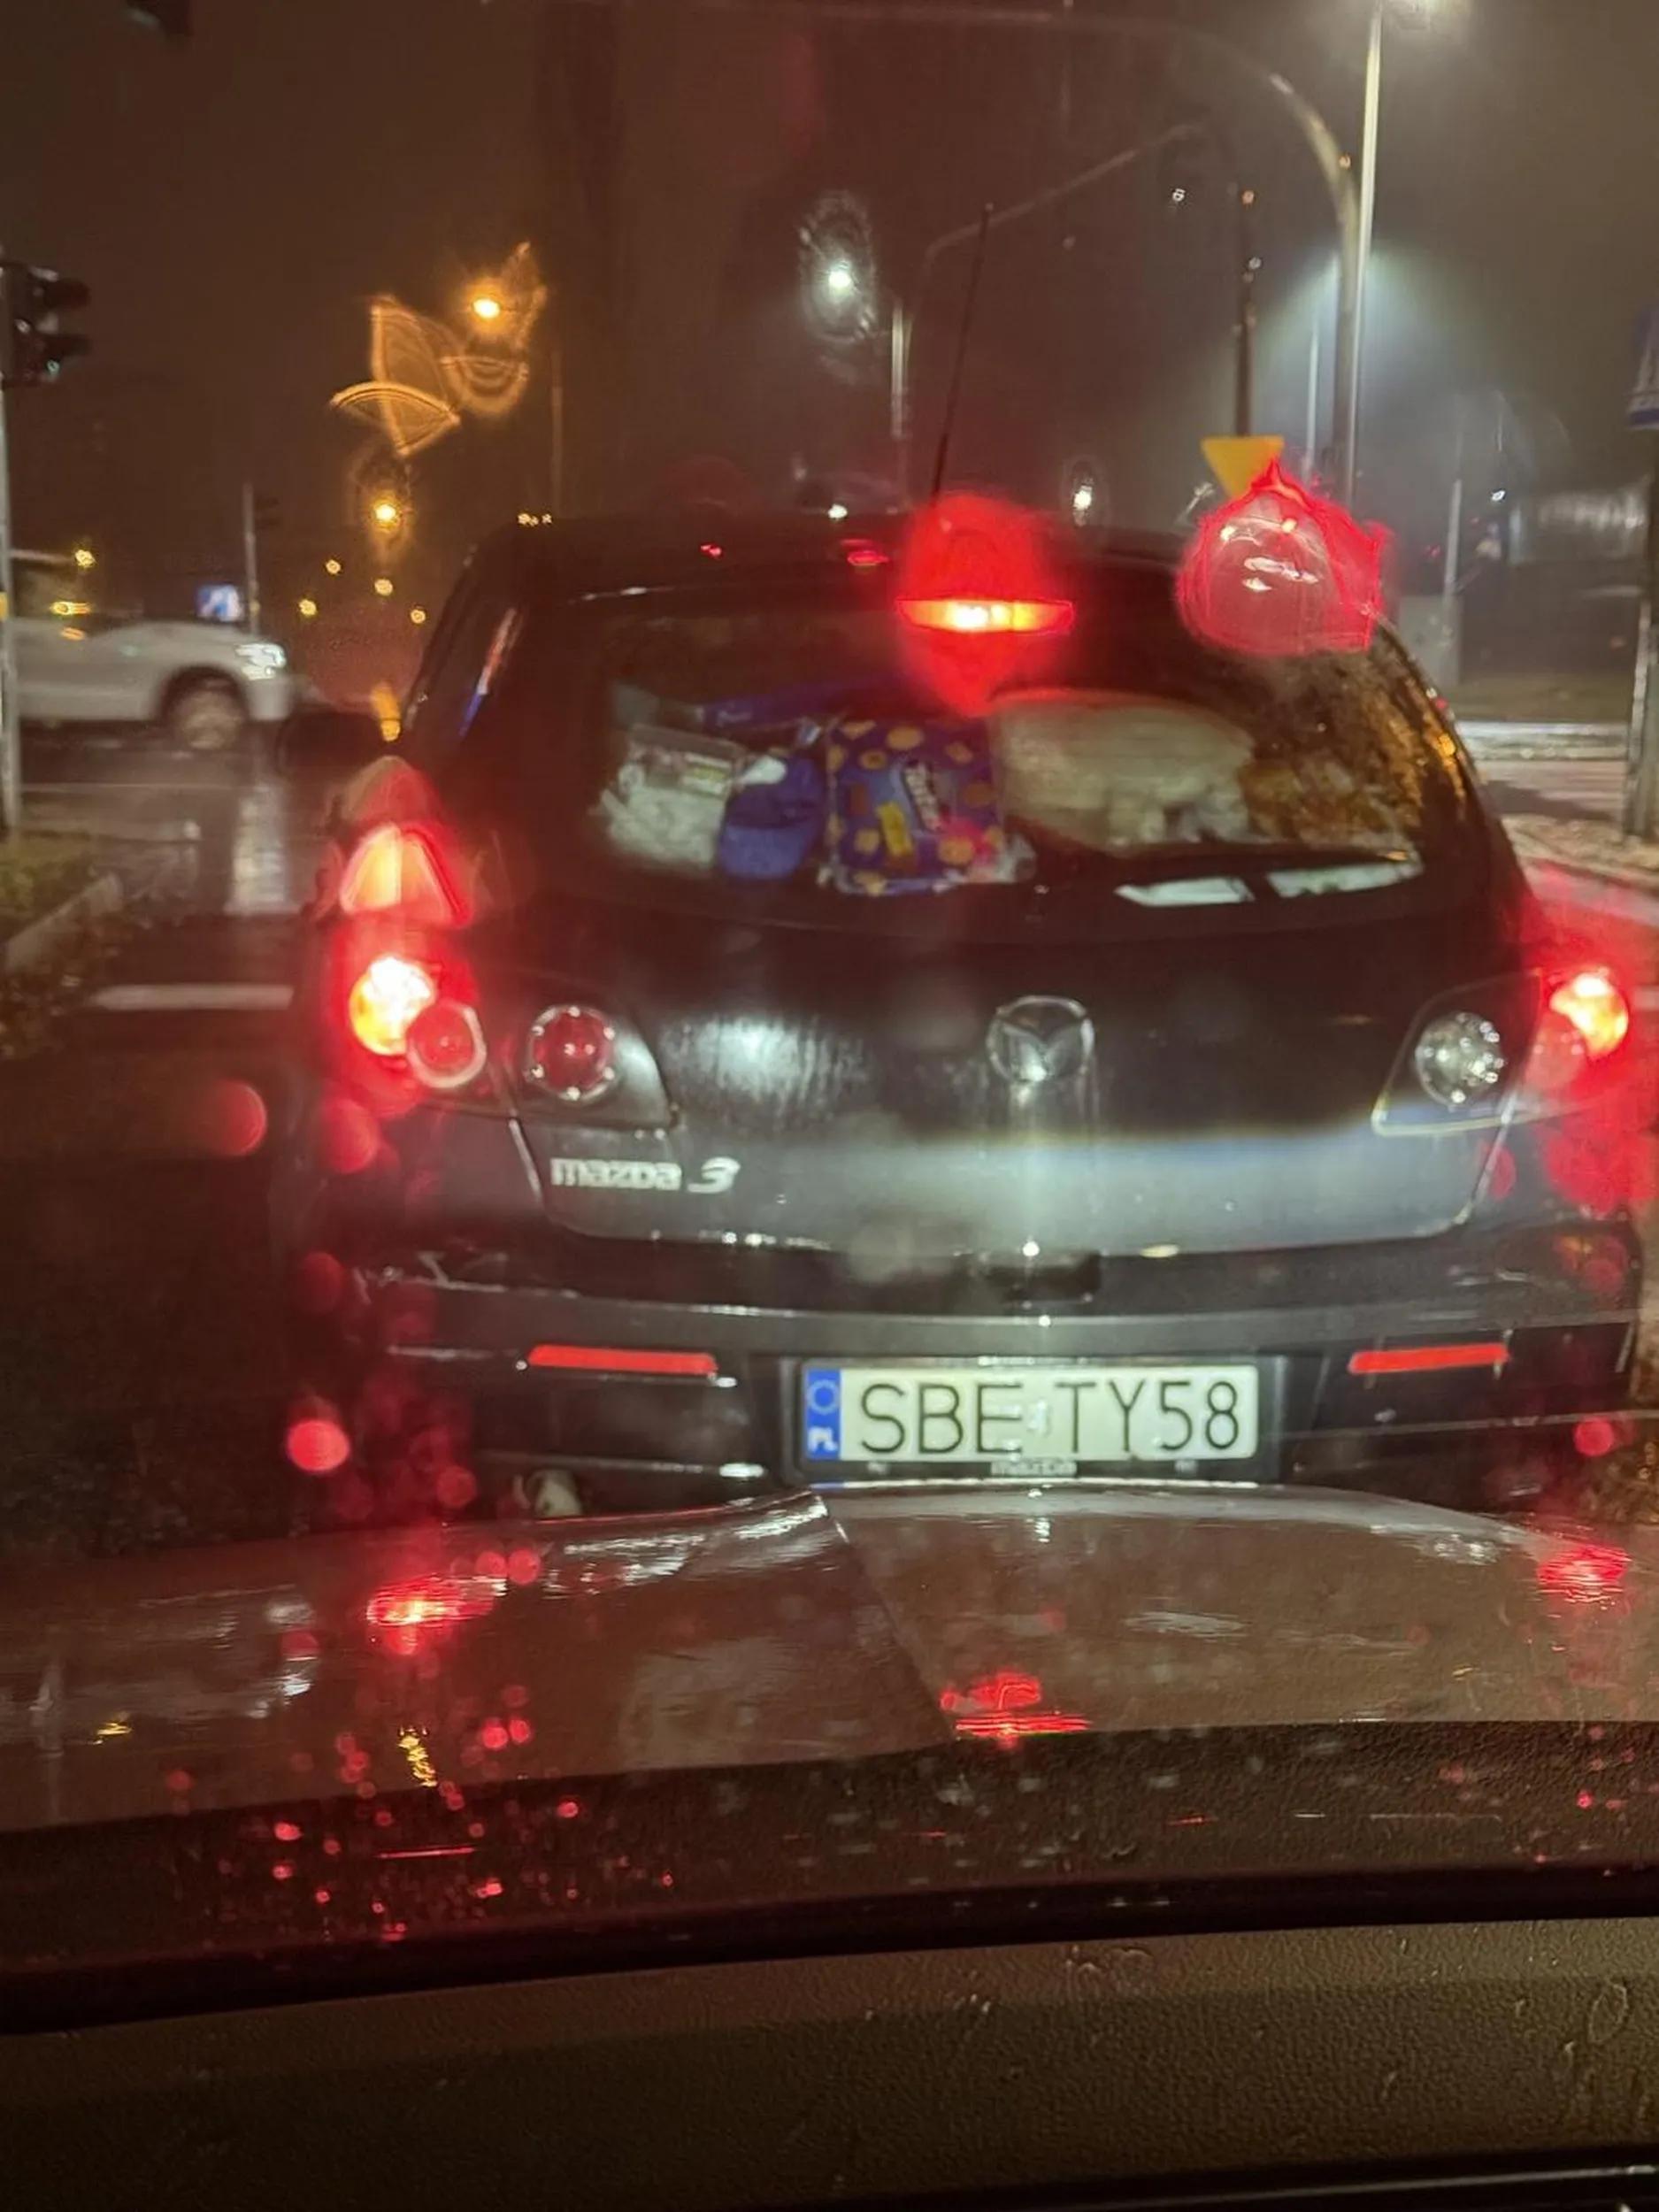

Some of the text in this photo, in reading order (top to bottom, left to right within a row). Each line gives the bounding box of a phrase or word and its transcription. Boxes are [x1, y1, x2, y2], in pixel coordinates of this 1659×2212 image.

[687, 1156, 741, 1193] 3
[860, 1379, 1240, 1455] SBE TY58
